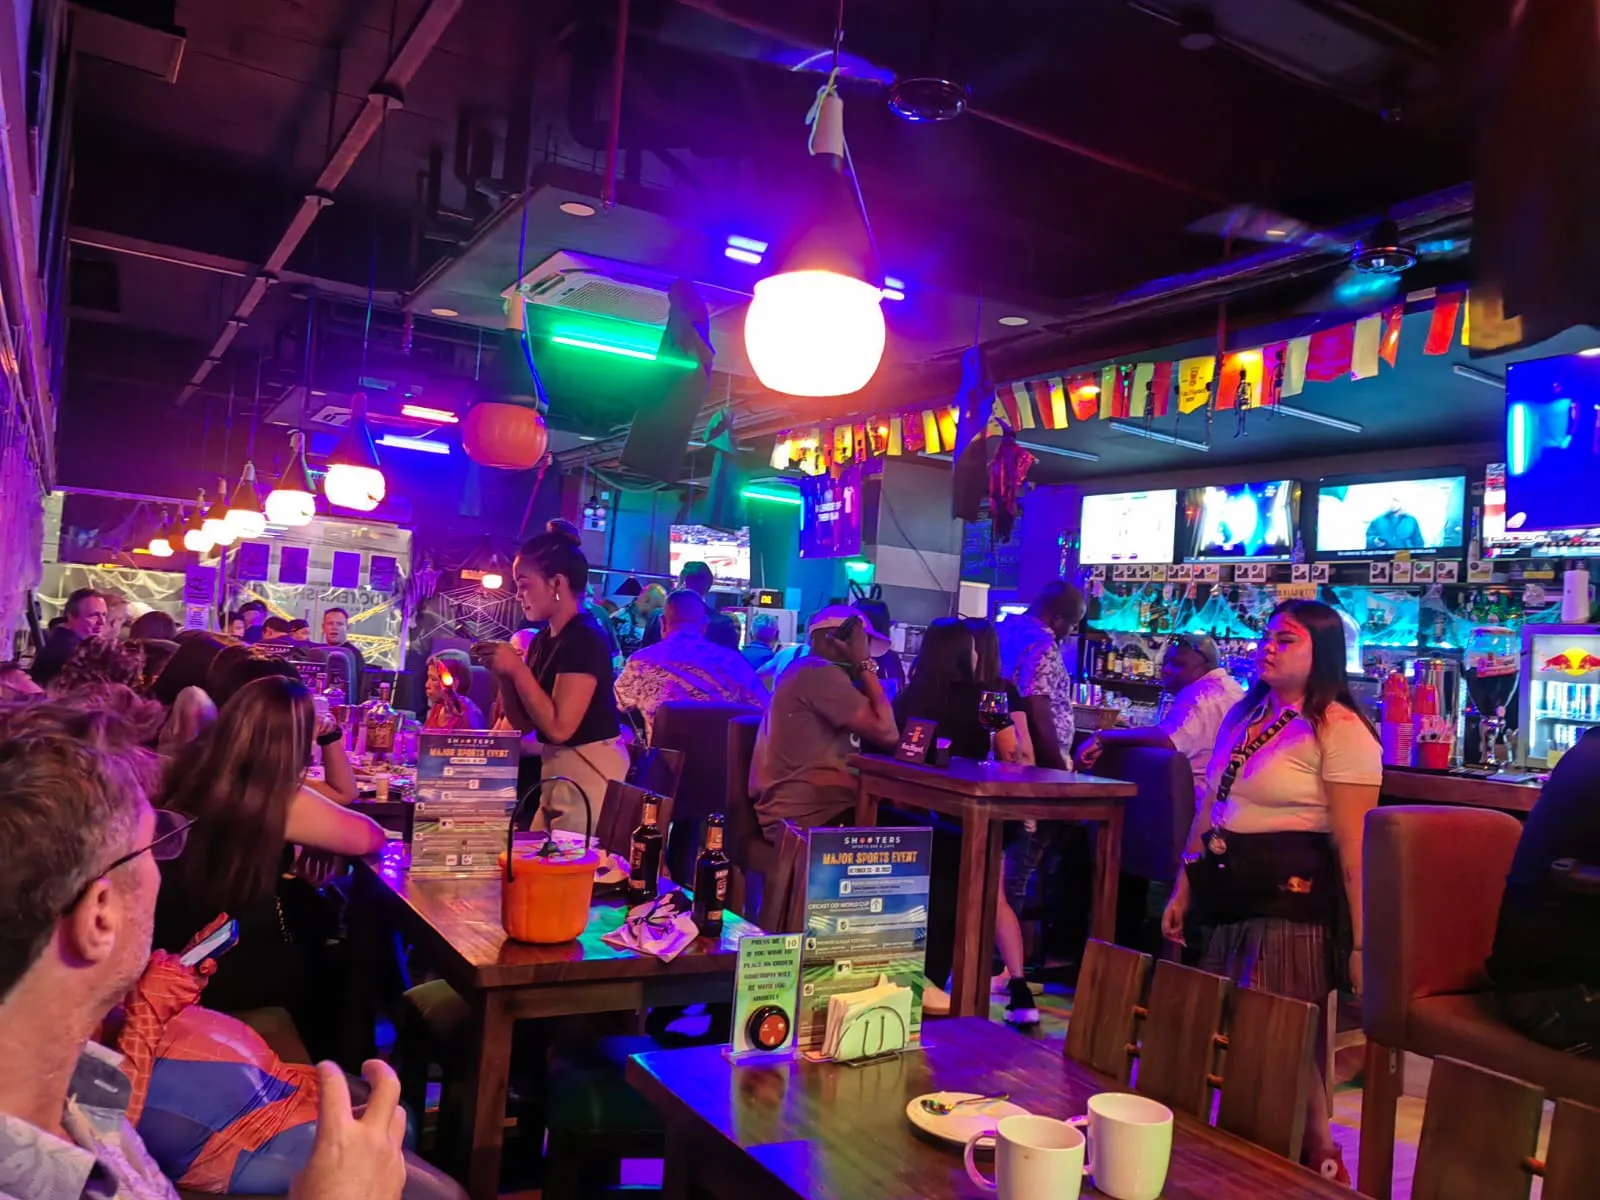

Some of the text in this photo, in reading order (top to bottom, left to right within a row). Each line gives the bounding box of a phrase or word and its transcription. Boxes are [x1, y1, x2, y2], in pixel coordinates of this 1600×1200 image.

[430, 748, 508, 757] MAJOR SPORTS EVENT
[823, 850, 918, 864] MAJOR SPORTS EVENT
